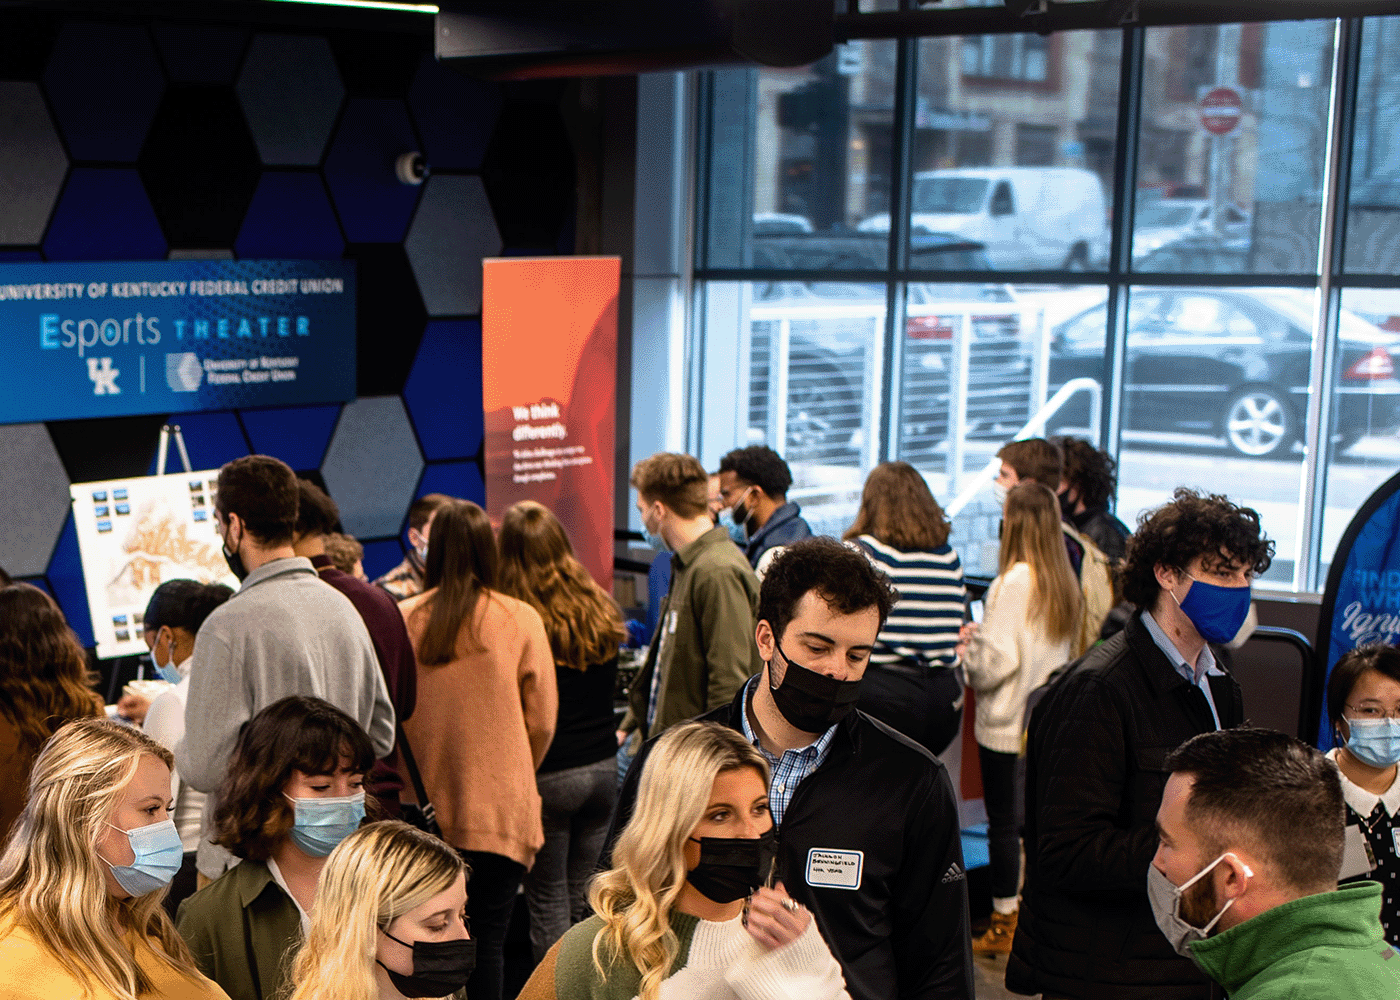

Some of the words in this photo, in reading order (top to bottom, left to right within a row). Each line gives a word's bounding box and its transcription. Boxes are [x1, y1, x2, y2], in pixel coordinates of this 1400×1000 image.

[87, 282, 108, 298] OF
[111, 281, 187, 298] KENTUCKY
[189, 279, 249, 296] FEDERAL
[251, 278, 299, 295] CREDIT
[299, 278, 344, 294] UNION
[39, 313, 161, 358] Esports
[173, 316, 310, 340] THEATER
